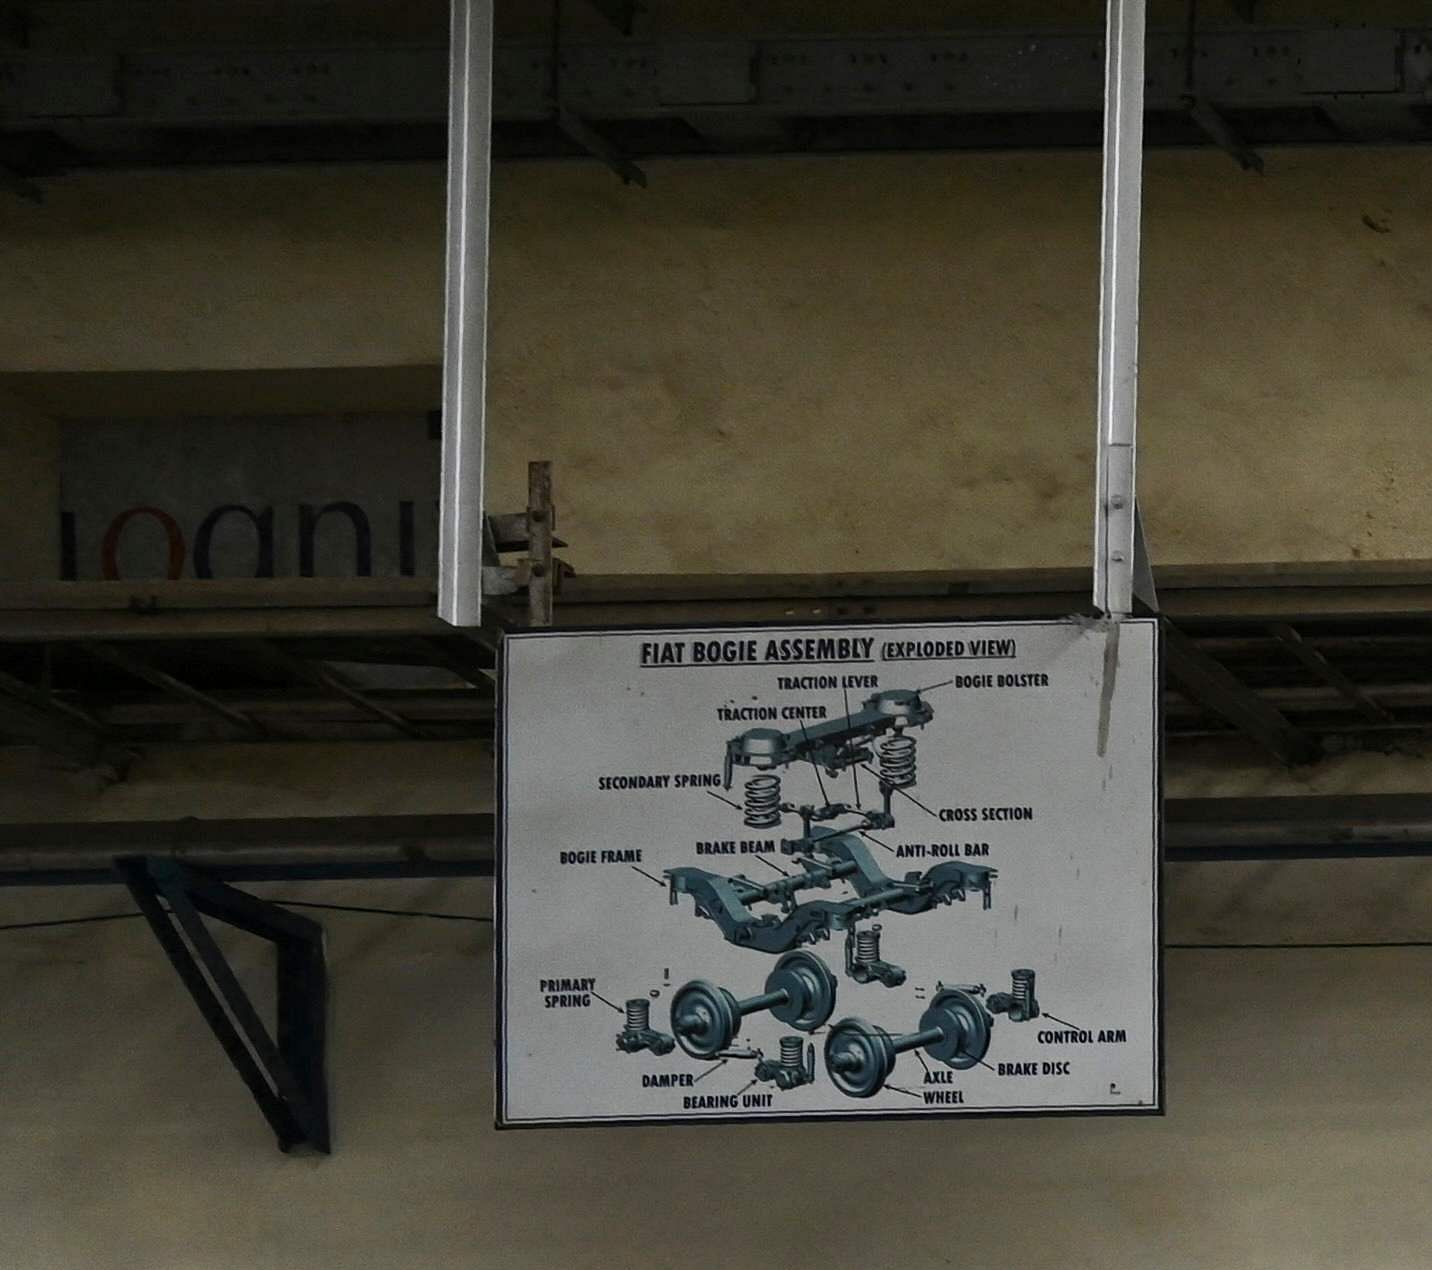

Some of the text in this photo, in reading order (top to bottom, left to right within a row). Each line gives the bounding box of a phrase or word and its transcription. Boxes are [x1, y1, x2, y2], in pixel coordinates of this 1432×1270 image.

[642, 639, 1016, 663] FIAT BOGIE ASSEMBLY (EXPLODED VIEW)
[777, 675, 879, 690] TRACTION LEVER
[955, 673, 1049, 688] BOGIE BOLSTER
[717, 706, 827, 720] TRACTION CENTER
[599, 774, 721, 790] SECONDARY SPRING
[939, 807, 1033, 822] CROSS SECTION
[697, 840, 776, 855] BRAKE BEAM
[896, 843, 989, 858] ANTI-ROLL BAR
[560, 849, 642, 864] BOGIE FRAME
[540, 978, 595, 993] PRIMARY
[545, 994, 591, 1008] SPRING
[1037, 1029, 1126, 1044] CONTROL ARM
[997, 1061, 1070, 1076] BRAKE DISC
[642, 1073, 694, 1088] DAMPER
[923, 1070, 953, 1084] AXLE
[683, 1094, 773, 1108] BEARING UNIT
[923, 1090, 964, 1104] WHEEL
